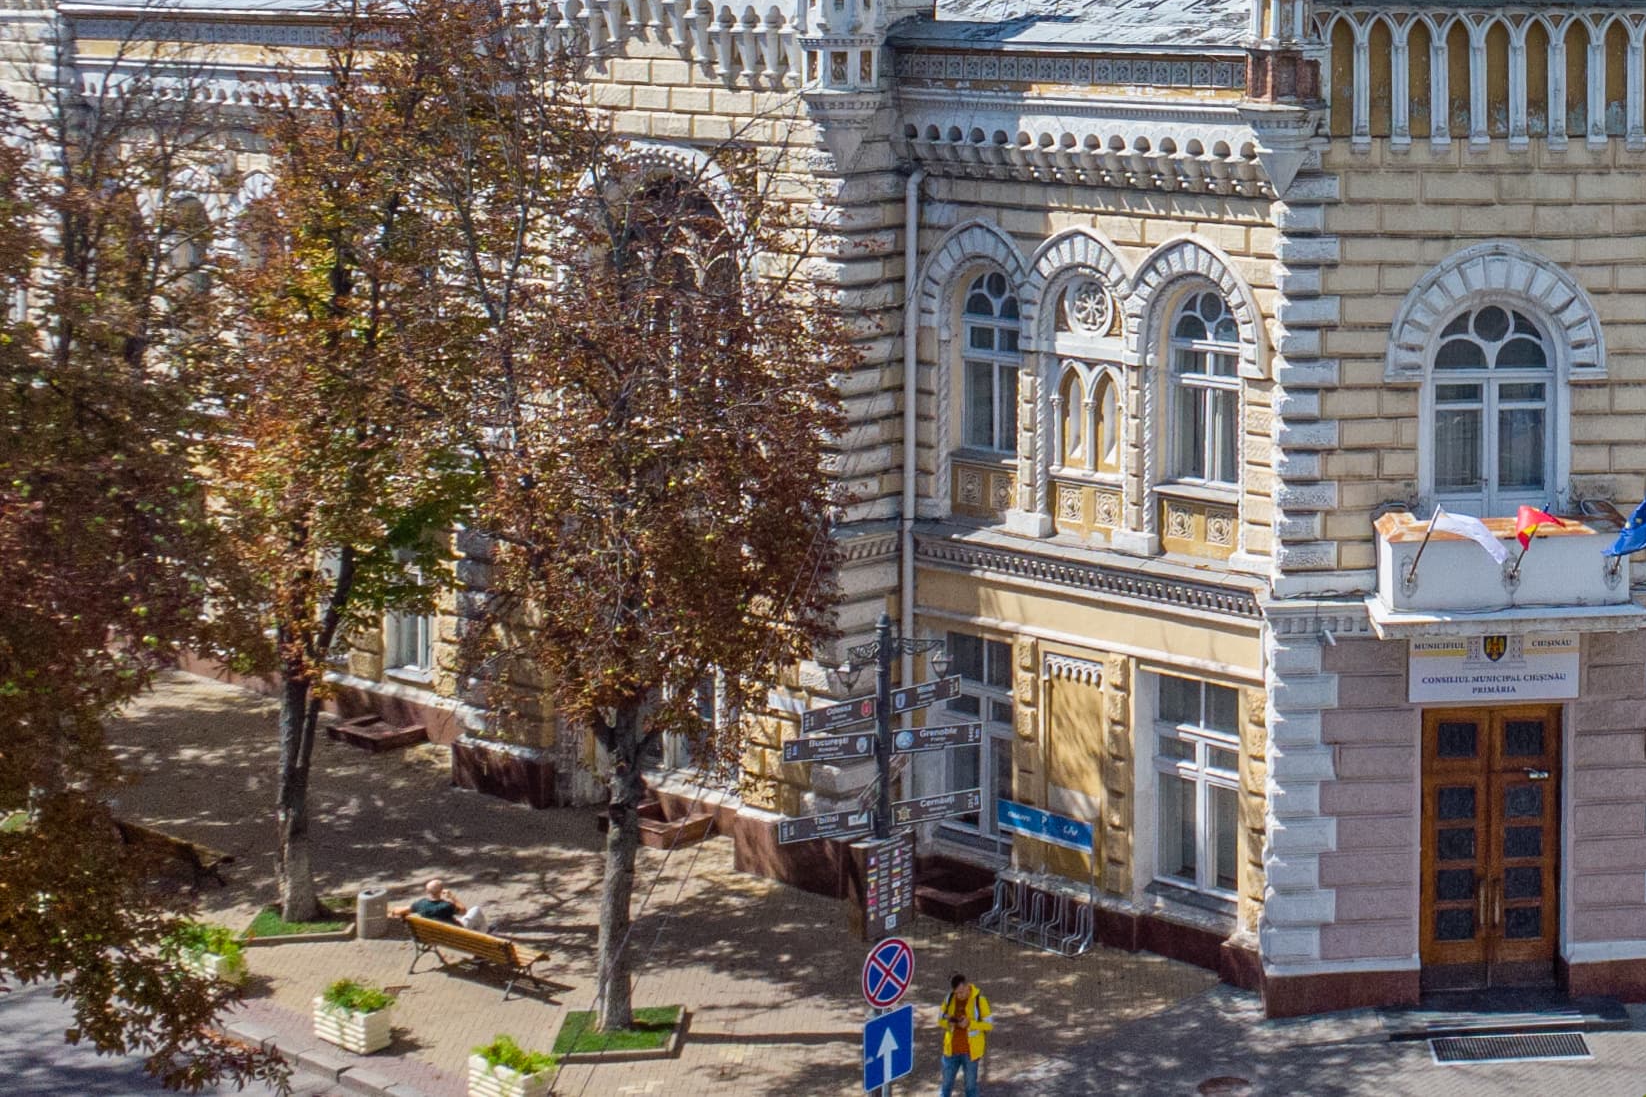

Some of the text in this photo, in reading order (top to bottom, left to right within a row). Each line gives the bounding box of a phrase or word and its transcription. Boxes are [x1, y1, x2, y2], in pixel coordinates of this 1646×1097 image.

[1414, 642, 1466, 650] MUNICIPIUL
[1422, 676, 1470, 684] CONSILIUL
[1471, 675, 1521, 683] MUNICIPAL
[1472, 685, 1516, 694] PRIMĂRIA
